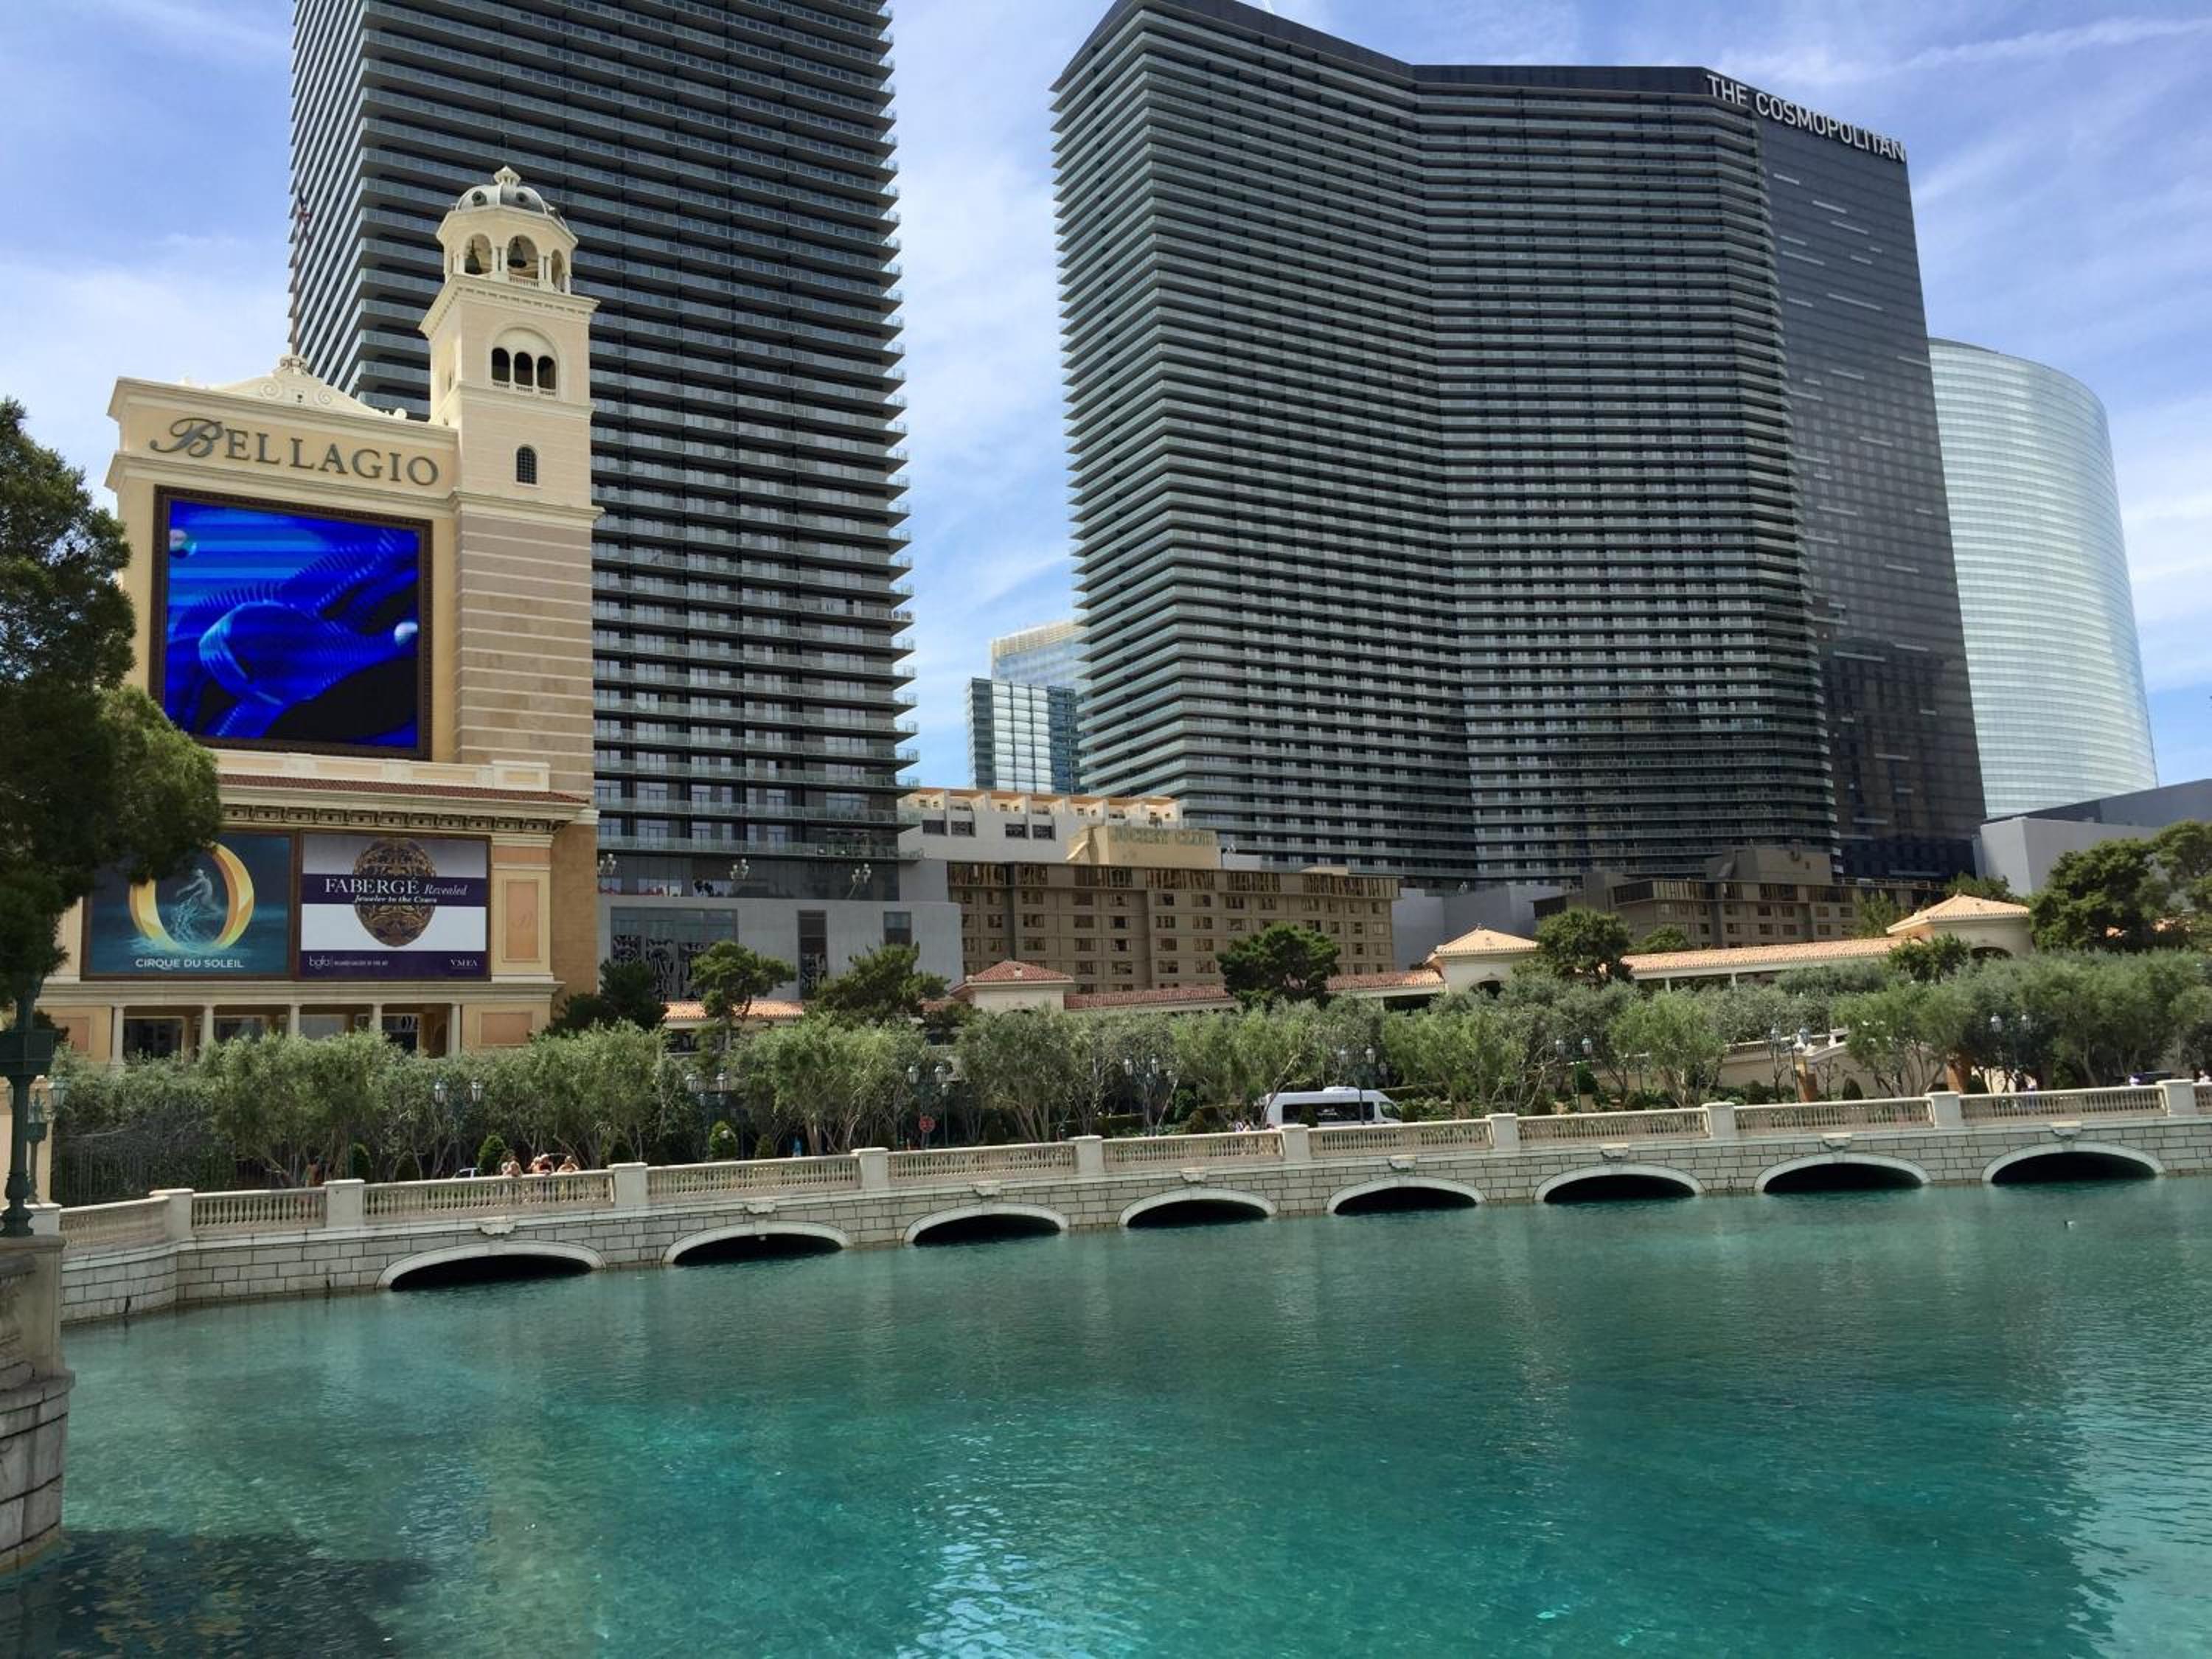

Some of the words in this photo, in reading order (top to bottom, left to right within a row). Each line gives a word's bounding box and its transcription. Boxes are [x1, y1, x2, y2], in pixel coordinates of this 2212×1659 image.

[1706, 74, 1748, 108] THE
[1756, 91, 1907, 163] COSMOPOLITAN
[149, 417, 439, 486] BELLAGIO
[324, 876, 420, 895] FABERGÉ
[135, 958, 181, 970] CIRQUE
[184, 959, 201, 968] DU
[204, 959, 245, 969] SOLEIL
